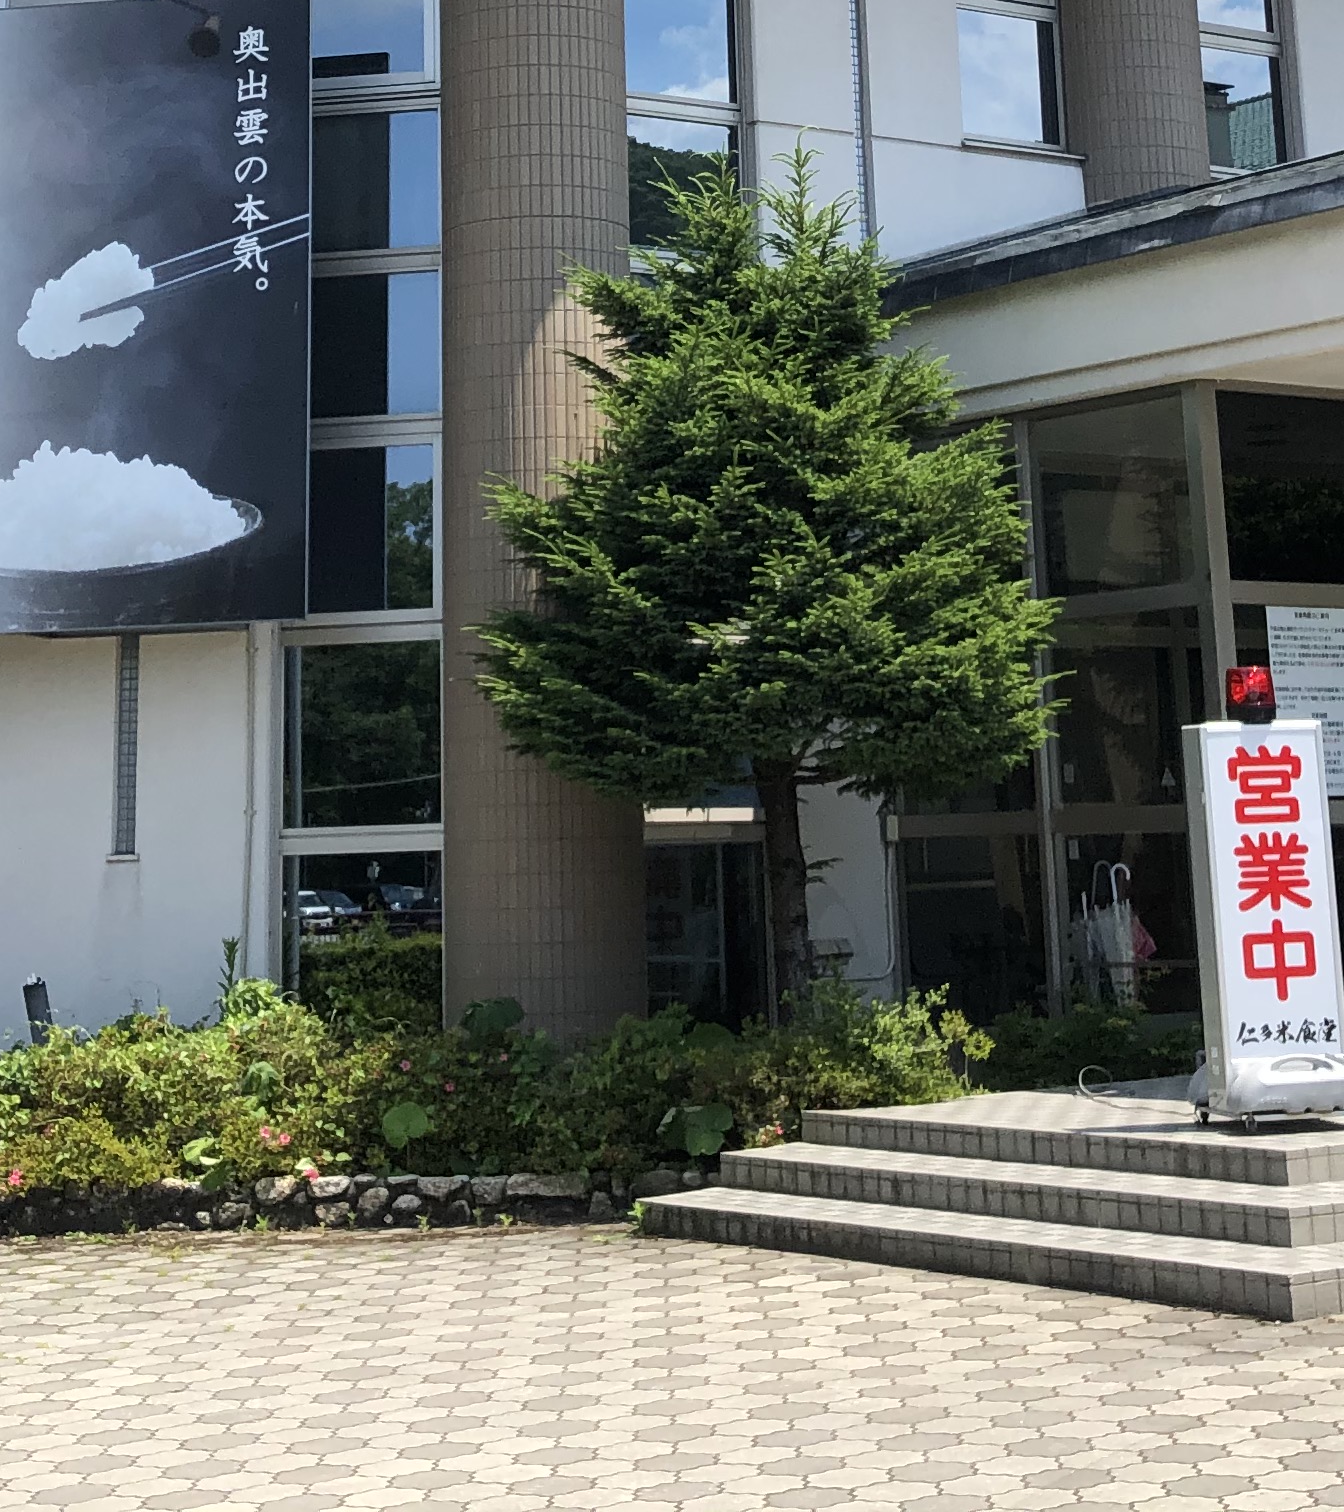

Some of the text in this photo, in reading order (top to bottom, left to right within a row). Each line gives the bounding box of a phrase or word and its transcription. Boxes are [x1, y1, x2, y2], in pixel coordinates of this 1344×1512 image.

[232, 26, 269, 291] 奥出雲の本気。
[1227, 745, 1317, 1001] 営業中
[1236, 1017, 1337, 1046] 仁多米食堂
